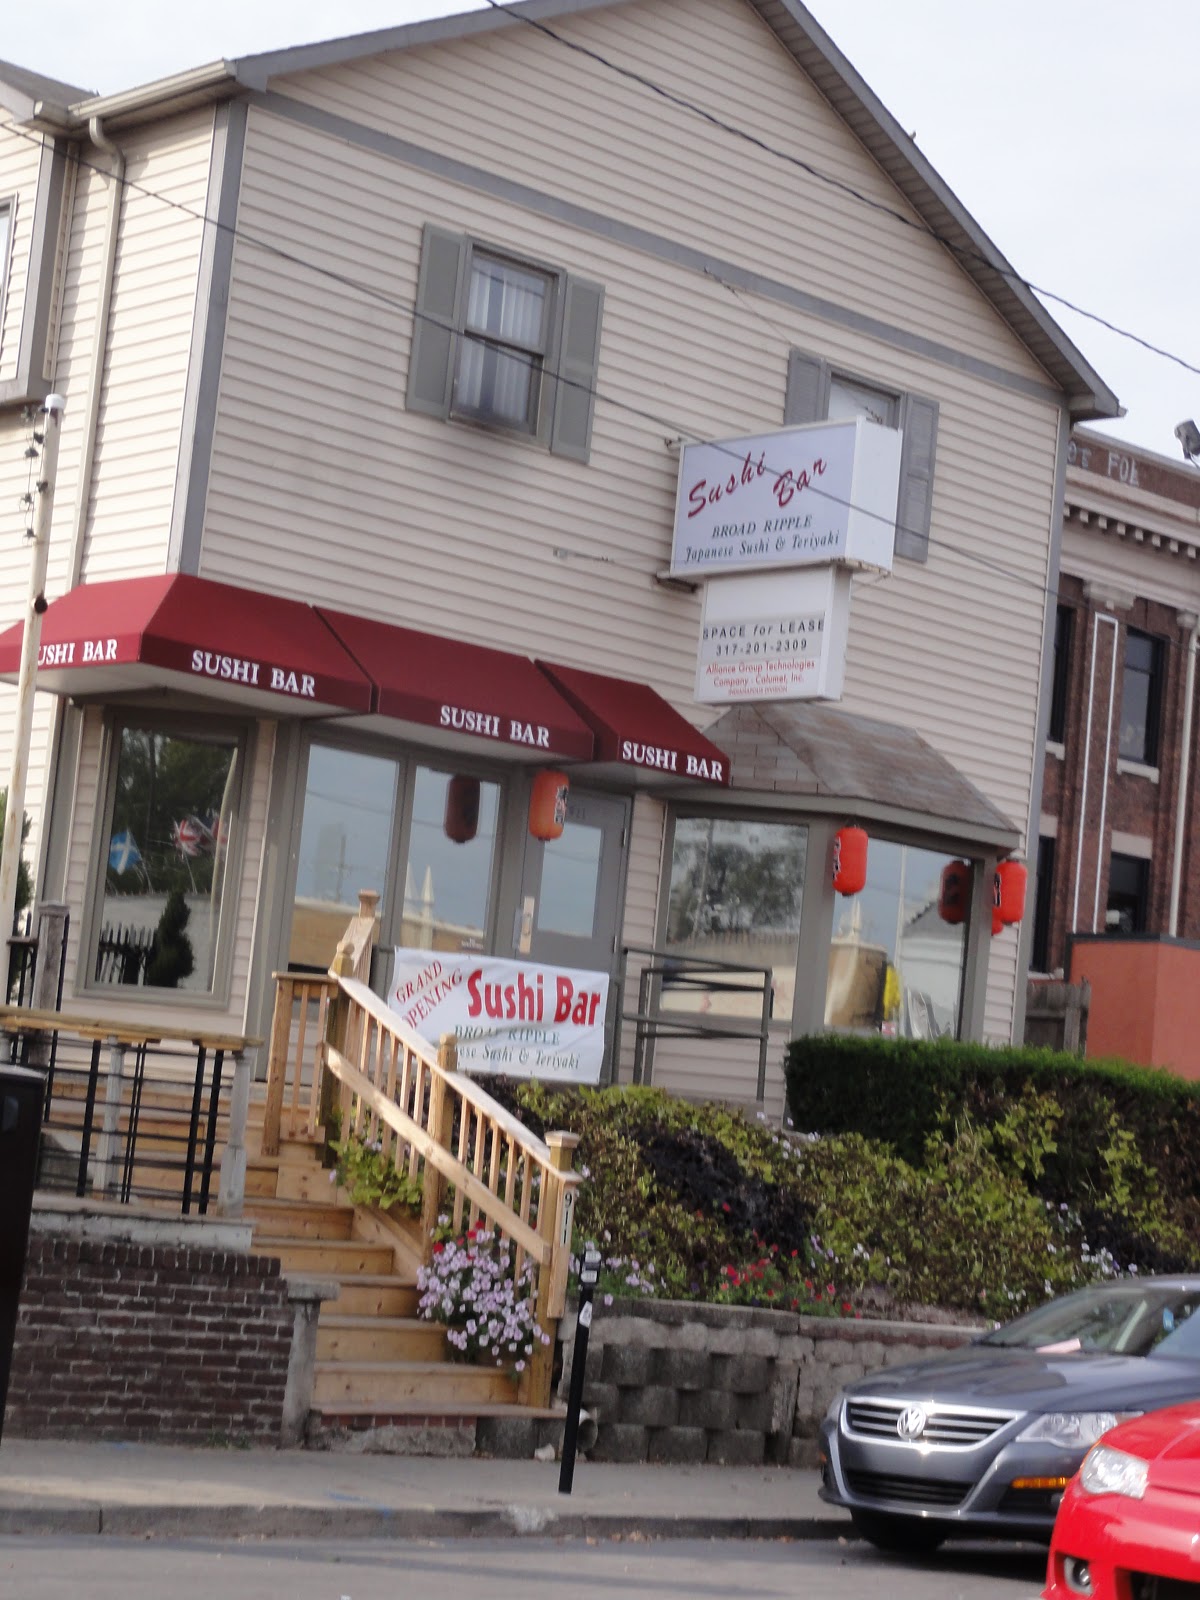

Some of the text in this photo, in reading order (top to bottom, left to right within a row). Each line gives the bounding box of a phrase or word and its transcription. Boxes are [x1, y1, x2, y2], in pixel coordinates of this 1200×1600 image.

[688, 451, 827, 518] Sushi Bar
[712, 514, 813, 539] BROAD RIPPLE
[685, 529, 840, 563] Japanese Sushi & Teriyaki
[702, 619, 824, 640] SPACE for LEASE
[37, 638, 118, 666] USHI BAR
[716, 639, 807, 656] 317-201-2309
[191, 649, 316, 697] SUSHI BAR
[706, 658, 815, 675] Alliance Group Technologies
[713, 677, 748, 687] Company
[440, 705, 550, 748] SUSHI BAR
[622, 741, 723, 781] SUSHI BAR
[396, 960, 442, 1004] GRAND
[467, 968, 600, 1026] Sushi Bar
[508, 1027, 560, 1046] RIPPLE
[482, 1044, 515, 1062] Sushi
[518, 1049, 529, 1065] &
[536, 1050, 581, 1071] Teriyaki
